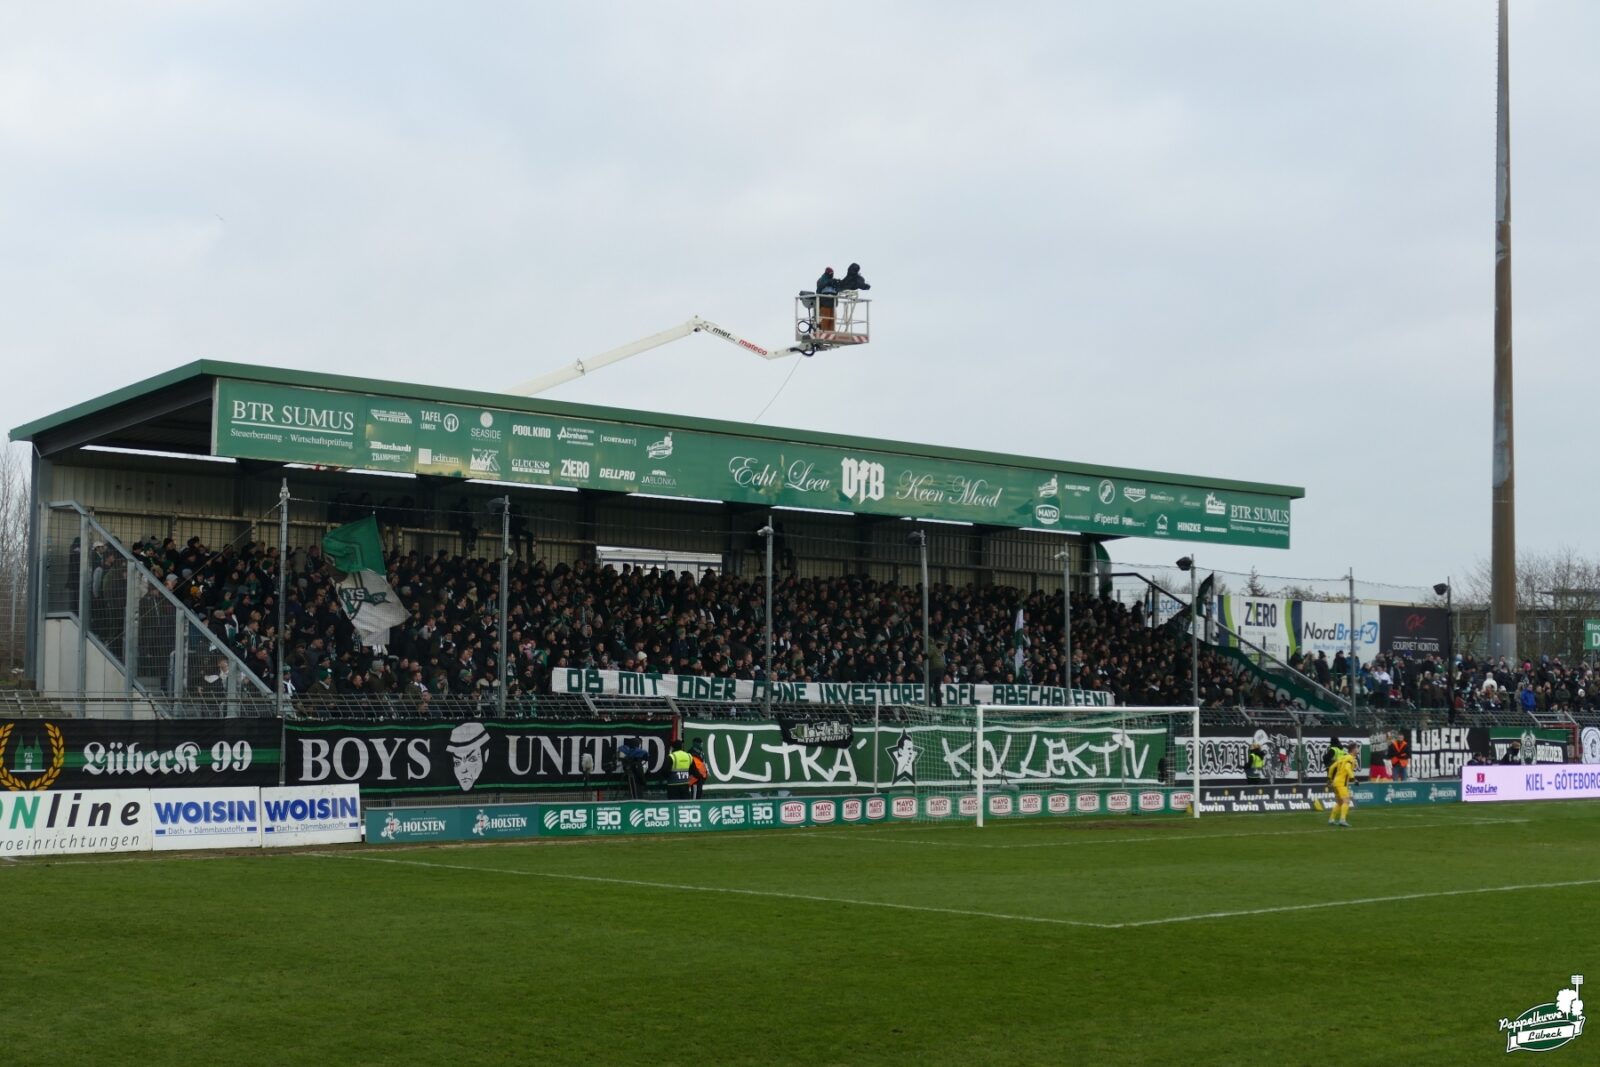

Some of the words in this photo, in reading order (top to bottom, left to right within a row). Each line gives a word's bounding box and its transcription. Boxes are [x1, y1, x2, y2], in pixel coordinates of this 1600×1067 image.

[738, 338, 768, 356] mateco
[232, 400, 275, 422] BTR
[282, 405, 354, 430] SUMUS
[421, 410, 442, 422] TAFEL
[231, 428, 283, 442] Steuerberatung
[290, 434, 353, 450] Wirtschaftsprüfung
[471, 428, 501, 440] SEASIDE
[432, 454, 459, 464] aditum
[599, 468, 636, 481] DELLPRO
[728, 456, 777, 488] Echt
[948, 475, 1003, 508] Mood
[1038, 508, 1057, 518] MAYO
[1230, 504, 1251, 520] BTR
[1254, 507, 1289, 524] SUMUS
[1392, 641, 1417, 651] GOURMET
[566, 670, 604, 694] OB
[618, 672, 663, 696] MIT
[678, 676, 736, 701] ODER
[752, 680, 809, 704] OHNE
[211, 740, 252, 772] 99
[299, 738, 432, 781] BOYS
[1526, 773, 1544, 791] KIEL
[1465, 784, 1484, 794] Stena
[1484, 784, 1497, 794] Line
[264, 798, 358, 822] WOISIN
[722, 805, 744, 818] FLS
[1200, 802, 1225, 812] bwin
[1233, 802, 1259, 811] bwin
[1264, 801, 1285, 810] bwin
[1289, 801, 1310, 809] bwin
[154, 800, 256, 824] WOISIN
[560, 809, 588, 822] FLS
[596, 811, 621, 825] 30
[644, 808, 670, 821] FLS
[678, 809, 700, 824] 30
[752, 806, 773, 820] 30
[276, 824, 294, 832] Dach-
[300, 822, 347, 831] Dämmbaustoffe
[402, 820, 446, 832] HOLSTEN
[491, 818, 528, 828] HOLSTEN
[194, 826, 244, 834] Dämmbaustoffe
